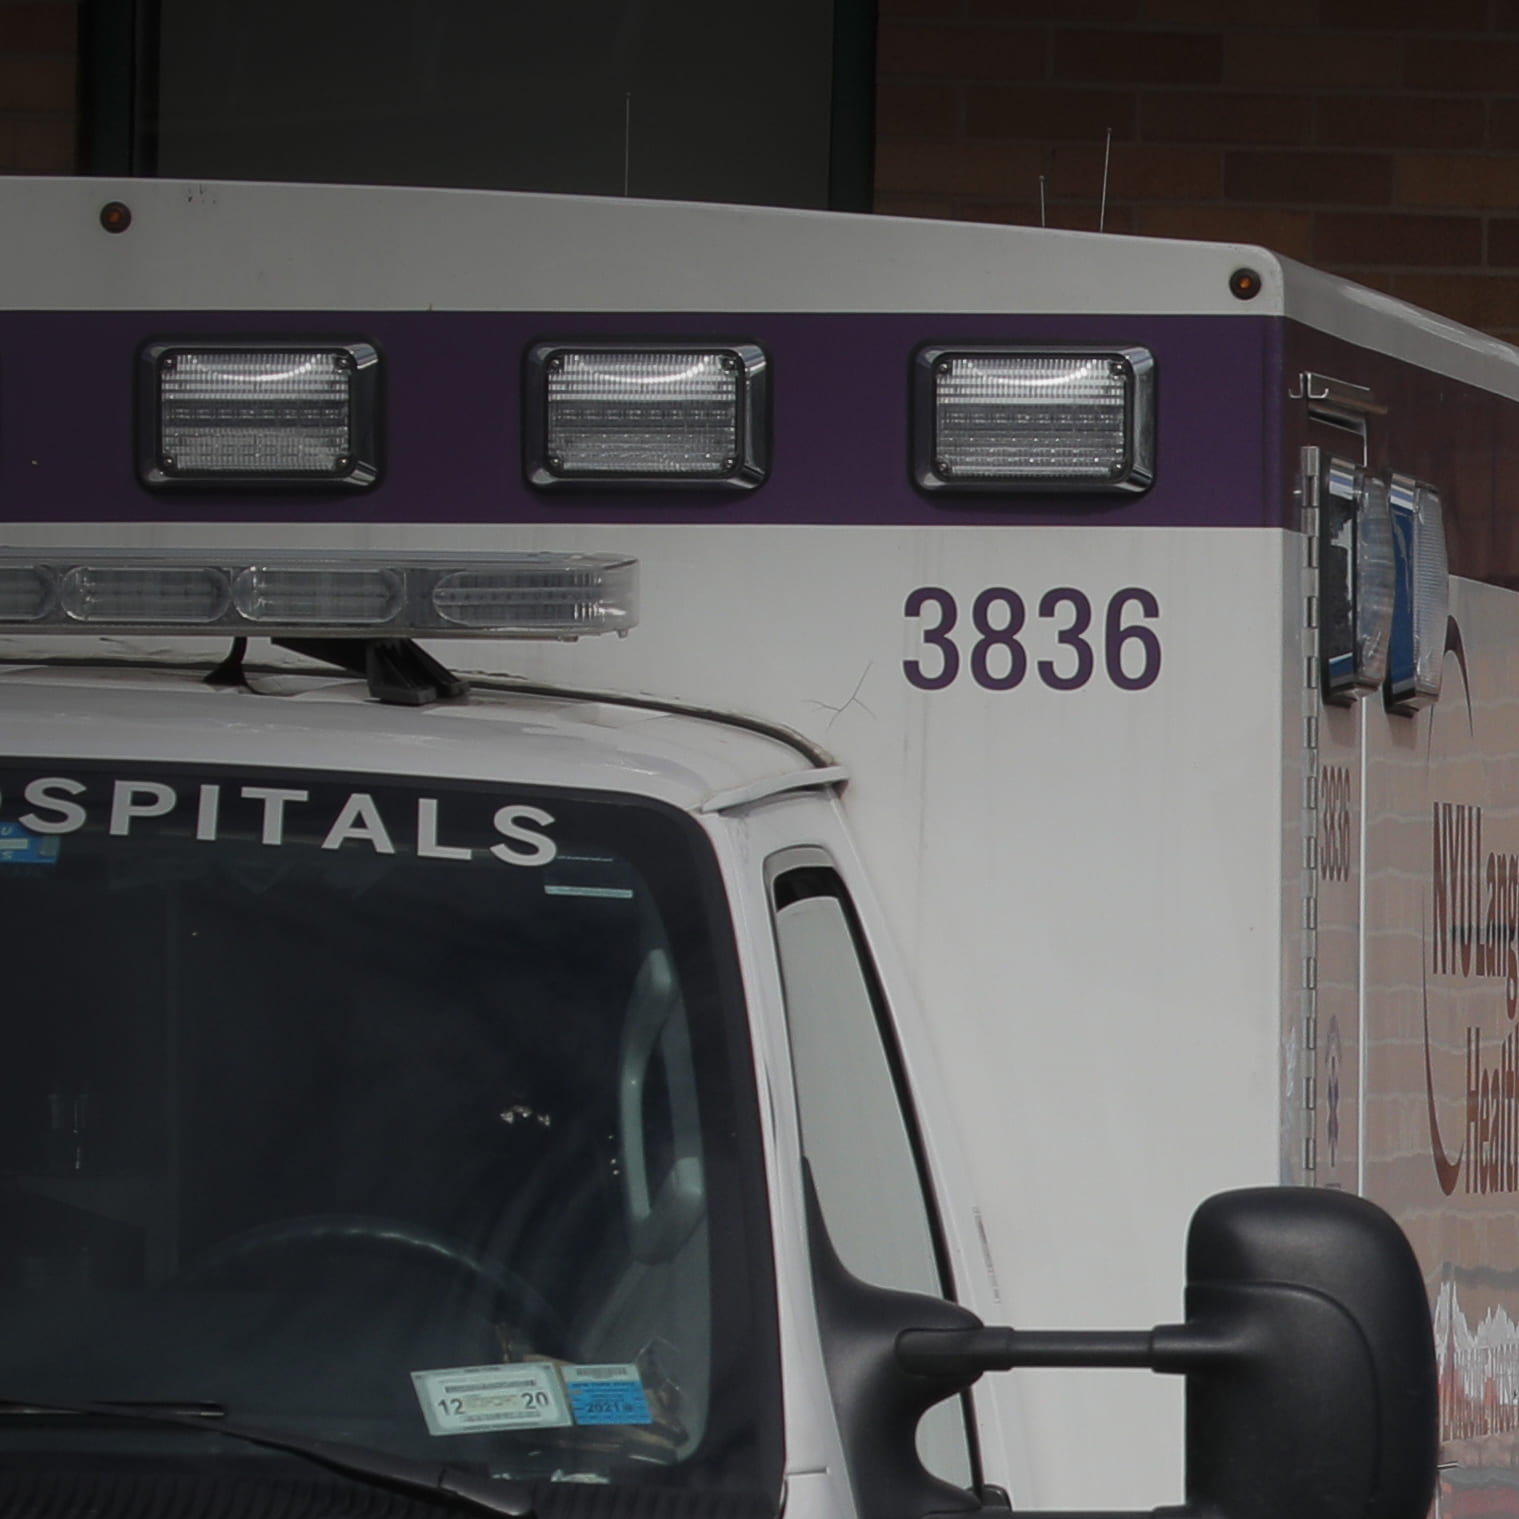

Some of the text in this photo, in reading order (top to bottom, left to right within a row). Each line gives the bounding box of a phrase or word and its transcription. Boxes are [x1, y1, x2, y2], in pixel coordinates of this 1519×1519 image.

[903, 586, 1162, 692] 3836
[0, 776, 559, 867] SPITALS
[1320, 765, 1350, 882] 3836
[1433, 802, 1473, 978] NYU
[438, 1391, 549, 1415] 12 20
